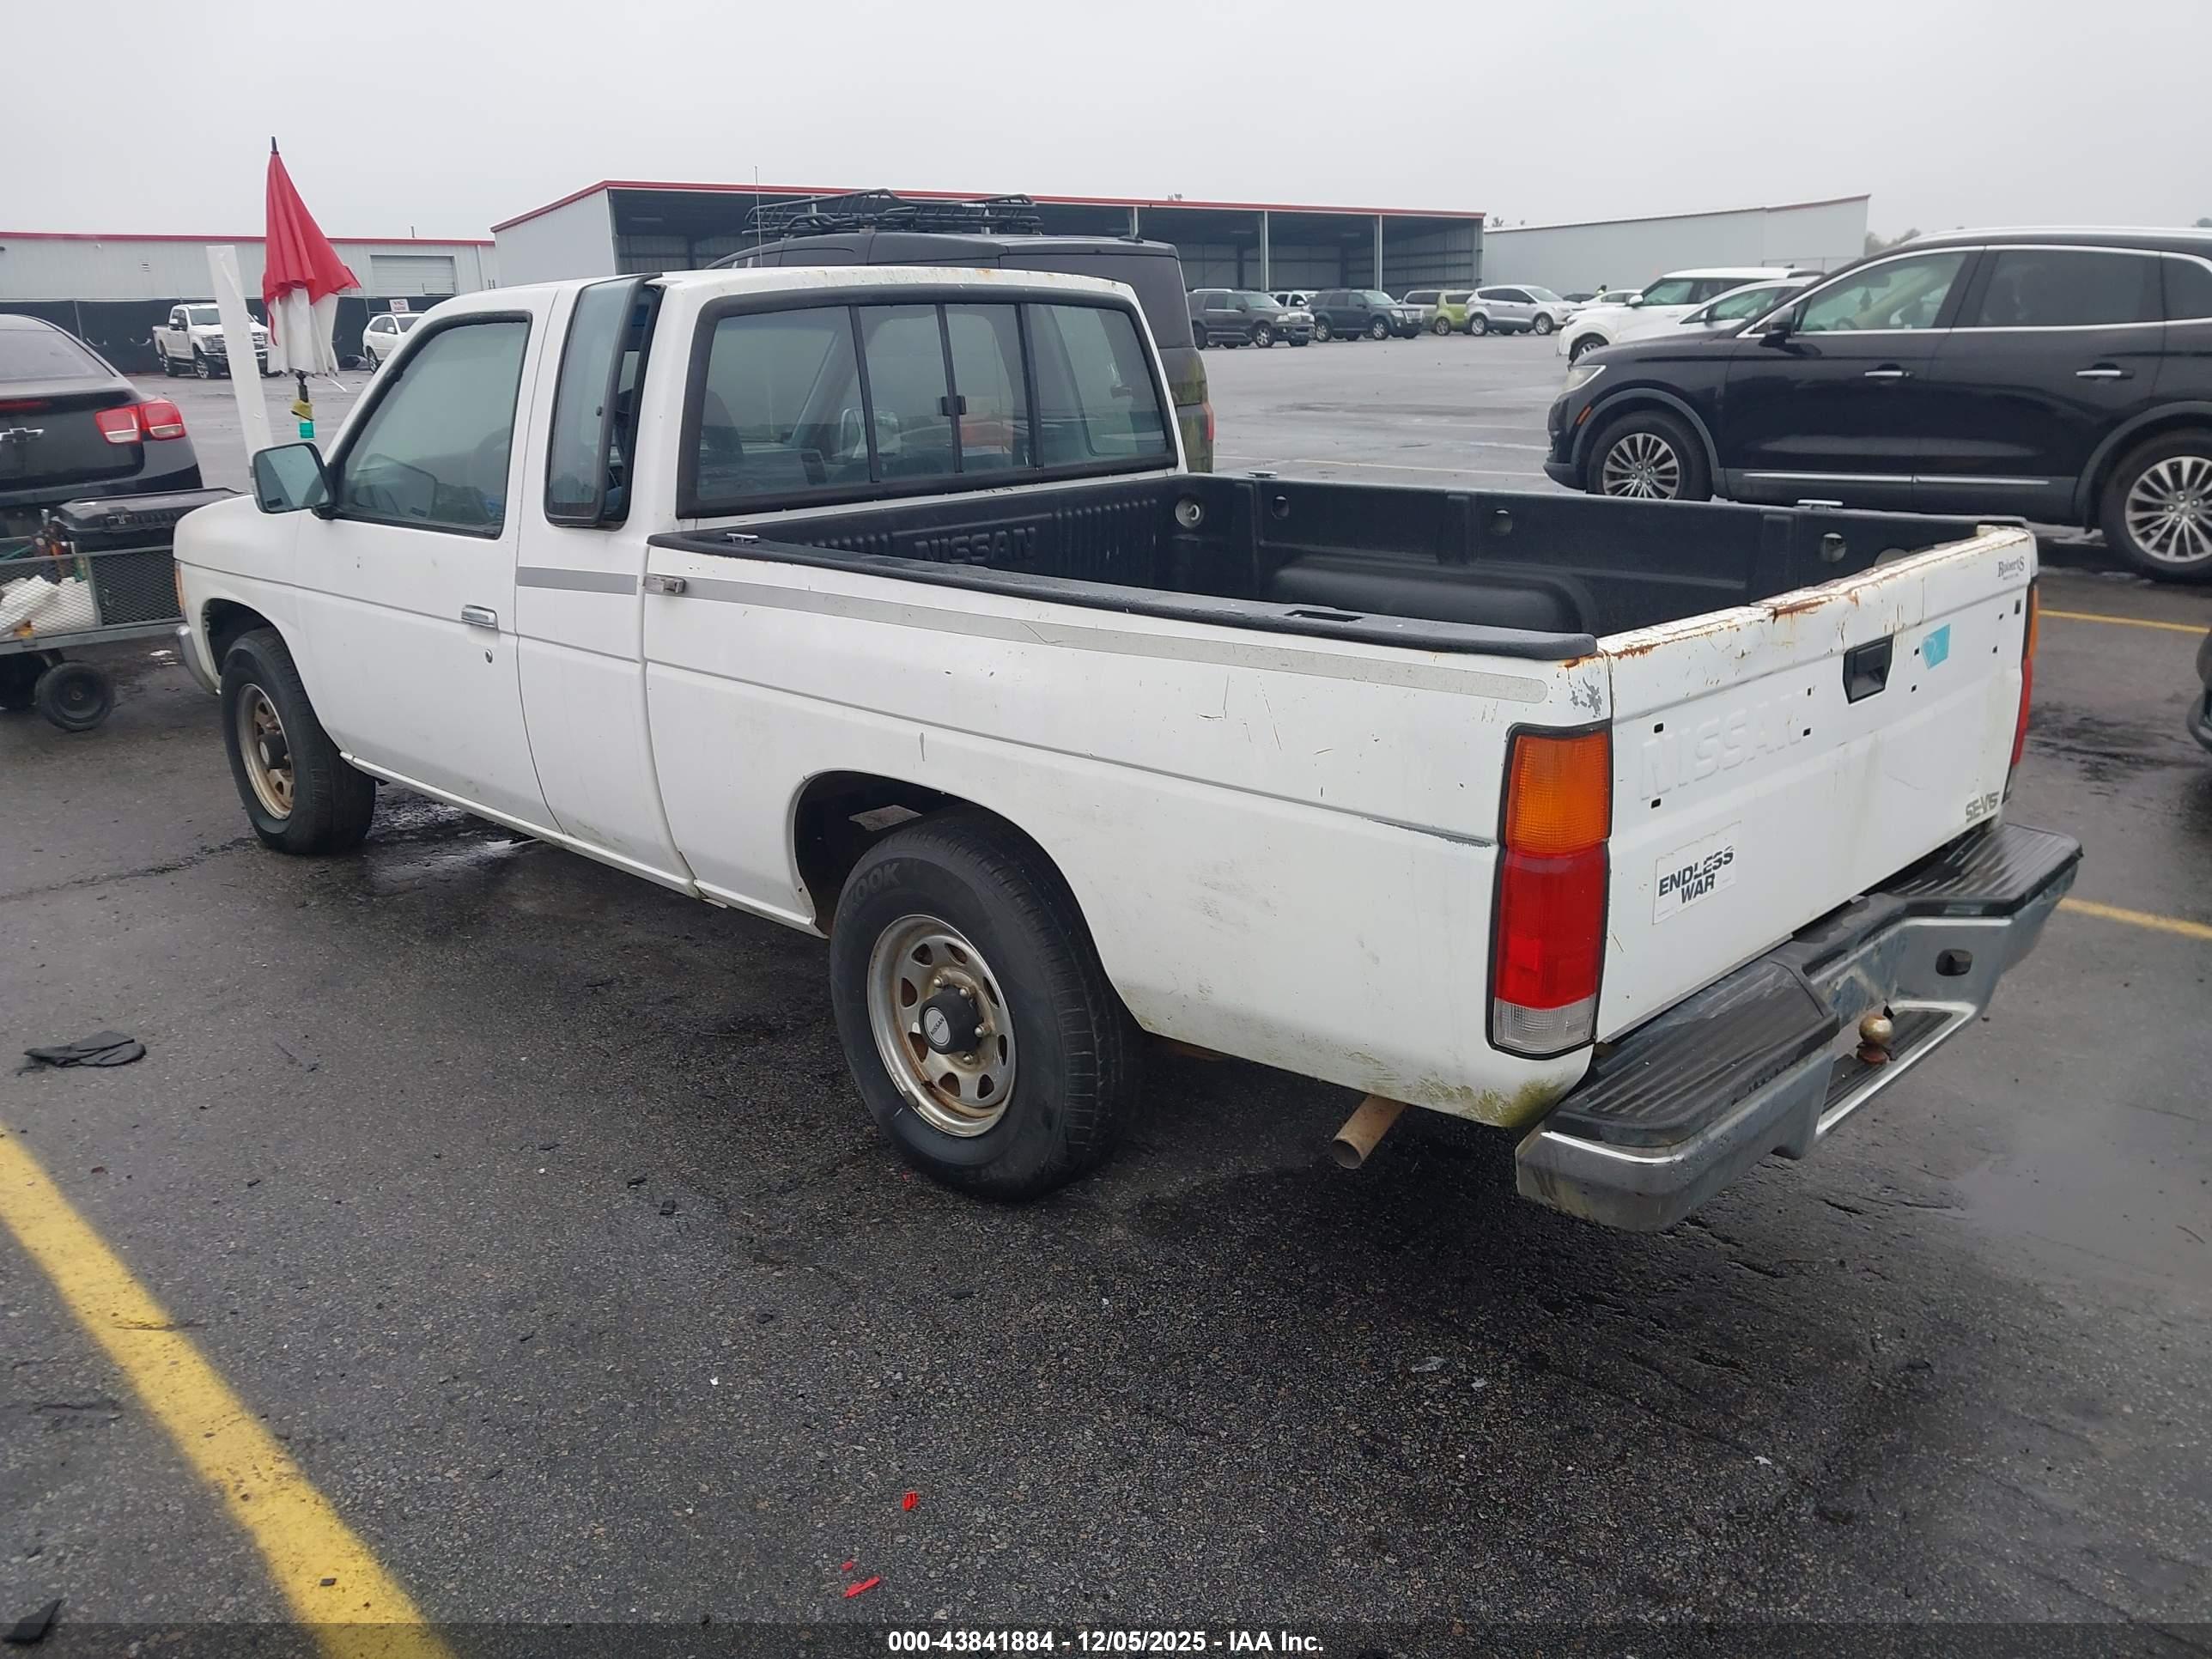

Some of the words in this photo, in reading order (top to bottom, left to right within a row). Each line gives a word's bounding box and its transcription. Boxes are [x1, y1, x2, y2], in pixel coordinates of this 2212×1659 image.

[915, 526, 1036, 564] NISSAN
[1641, 690, 1807, 800] NISSAN
[1658, 845, 1734, 897] ENDLESS
[1681, 872, 1716, 904] WAR
